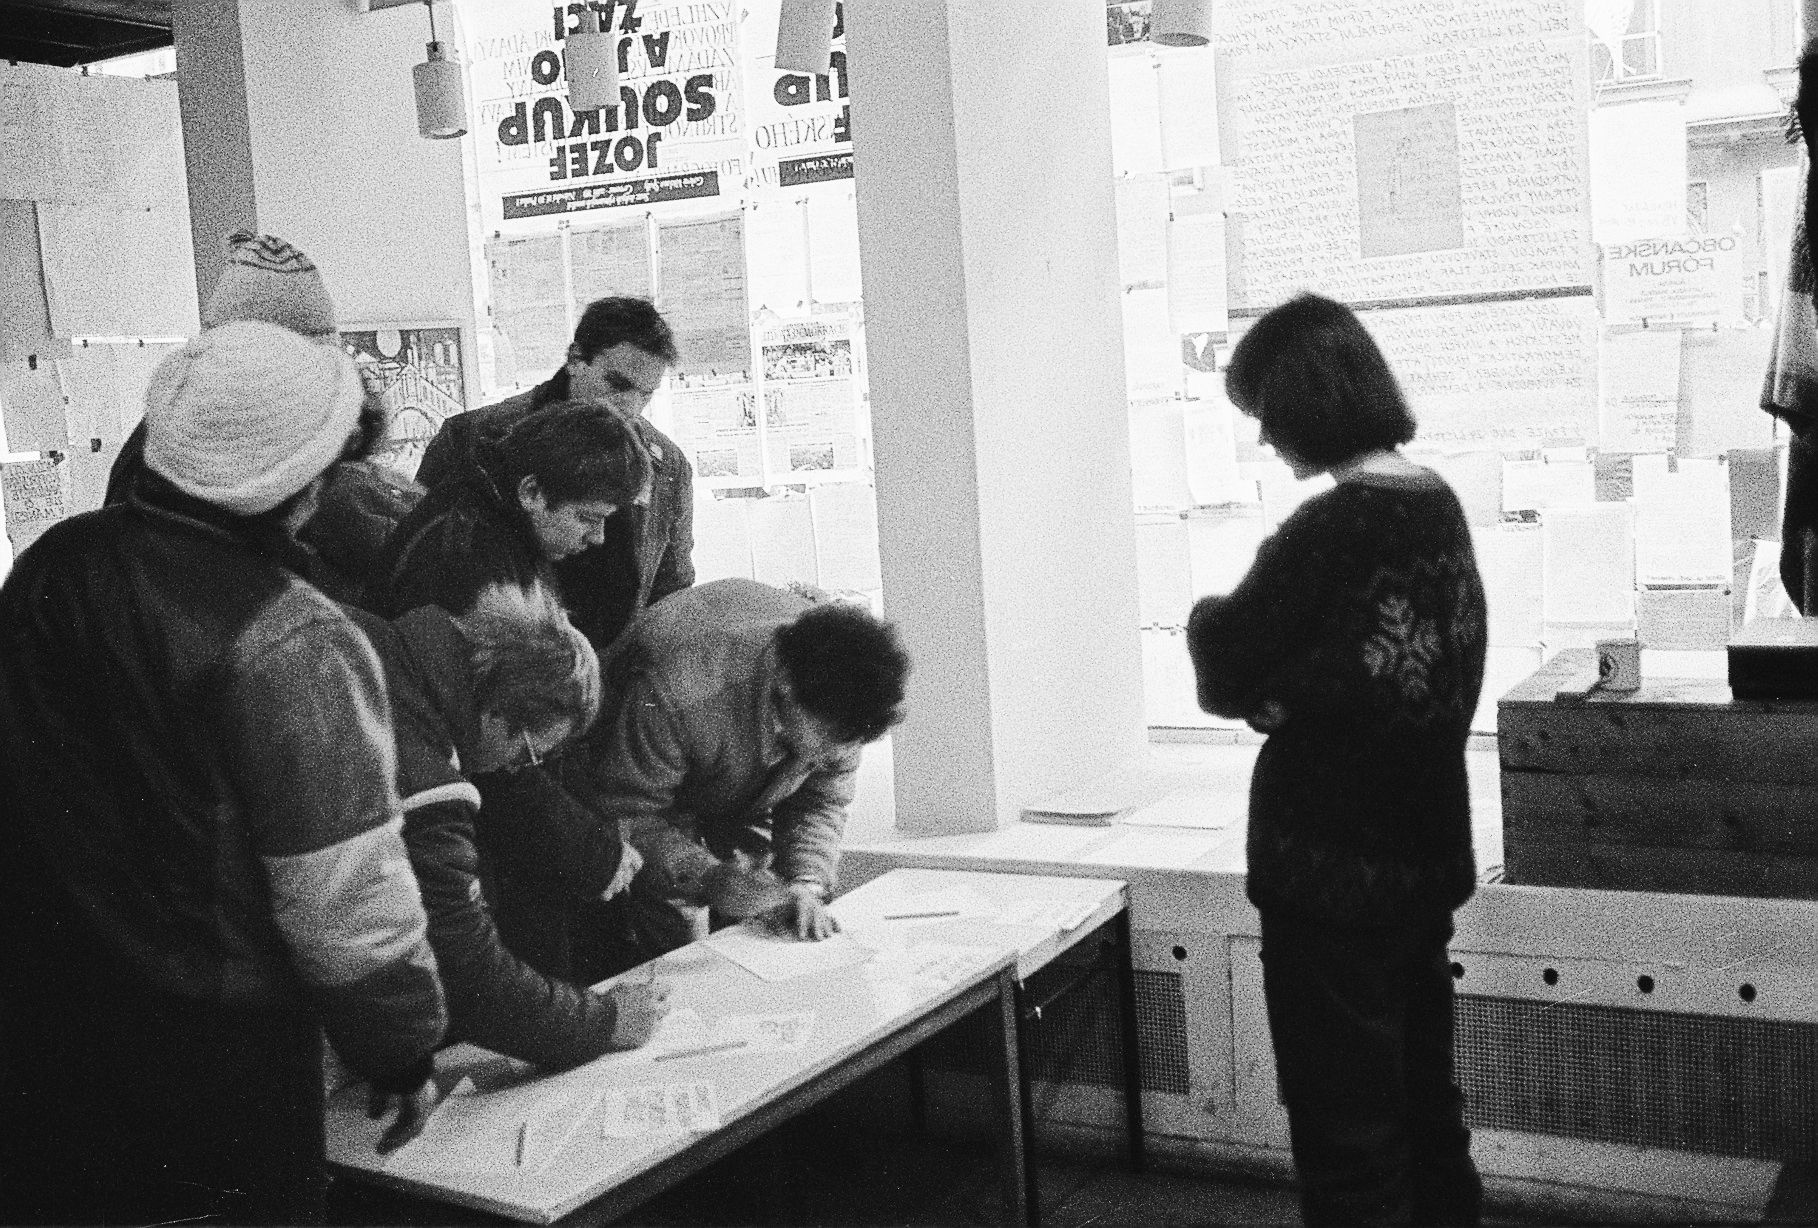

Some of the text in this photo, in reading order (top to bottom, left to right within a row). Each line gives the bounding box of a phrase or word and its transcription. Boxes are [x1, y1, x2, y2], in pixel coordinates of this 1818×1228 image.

[641, 30, 670, 68] A
[497, 73, 717, 146] SOUKUP
[549, 131, 662, 181] JOZEF
